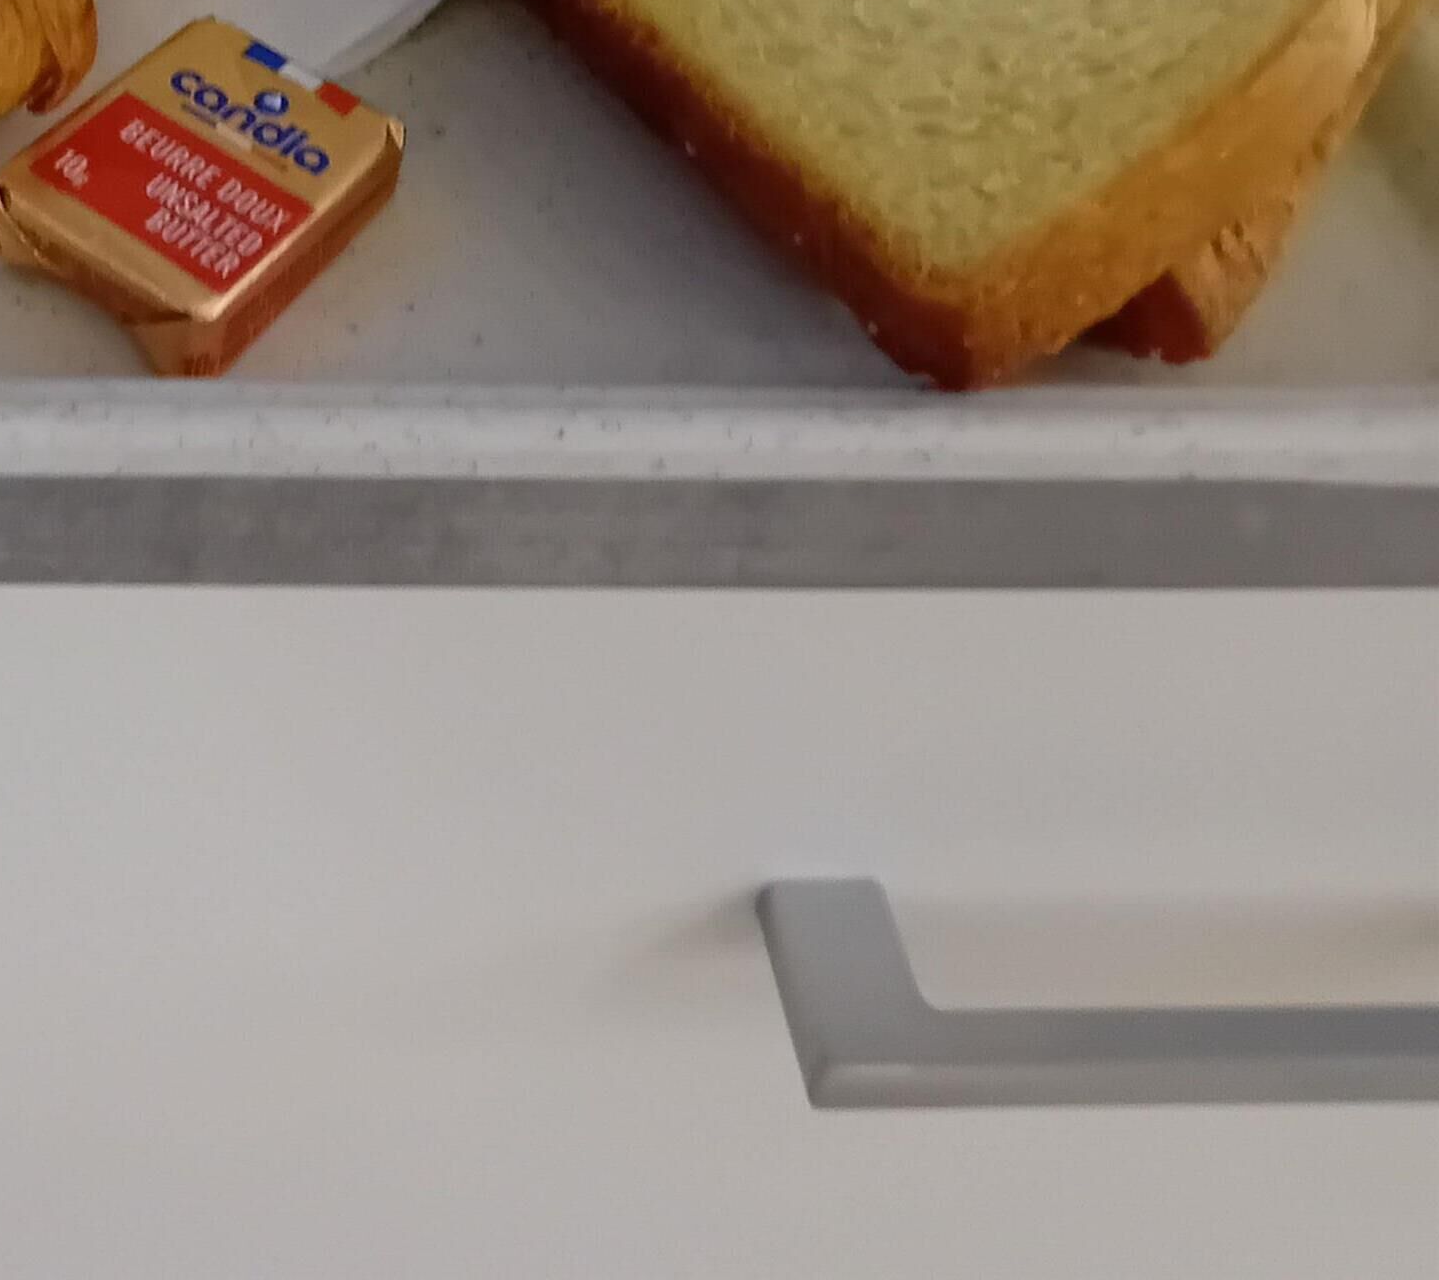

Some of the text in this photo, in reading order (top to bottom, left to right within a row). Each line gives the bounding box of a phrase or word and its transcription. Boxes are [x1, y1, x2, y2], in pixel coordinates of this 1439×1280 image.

[169, 68, 331, 178] candia
[119, 116, 291, 236] BEURRE DOUX
[145, 172, 265, 258] UNSALTED
[144, 210, 244, 280] BUTTER
